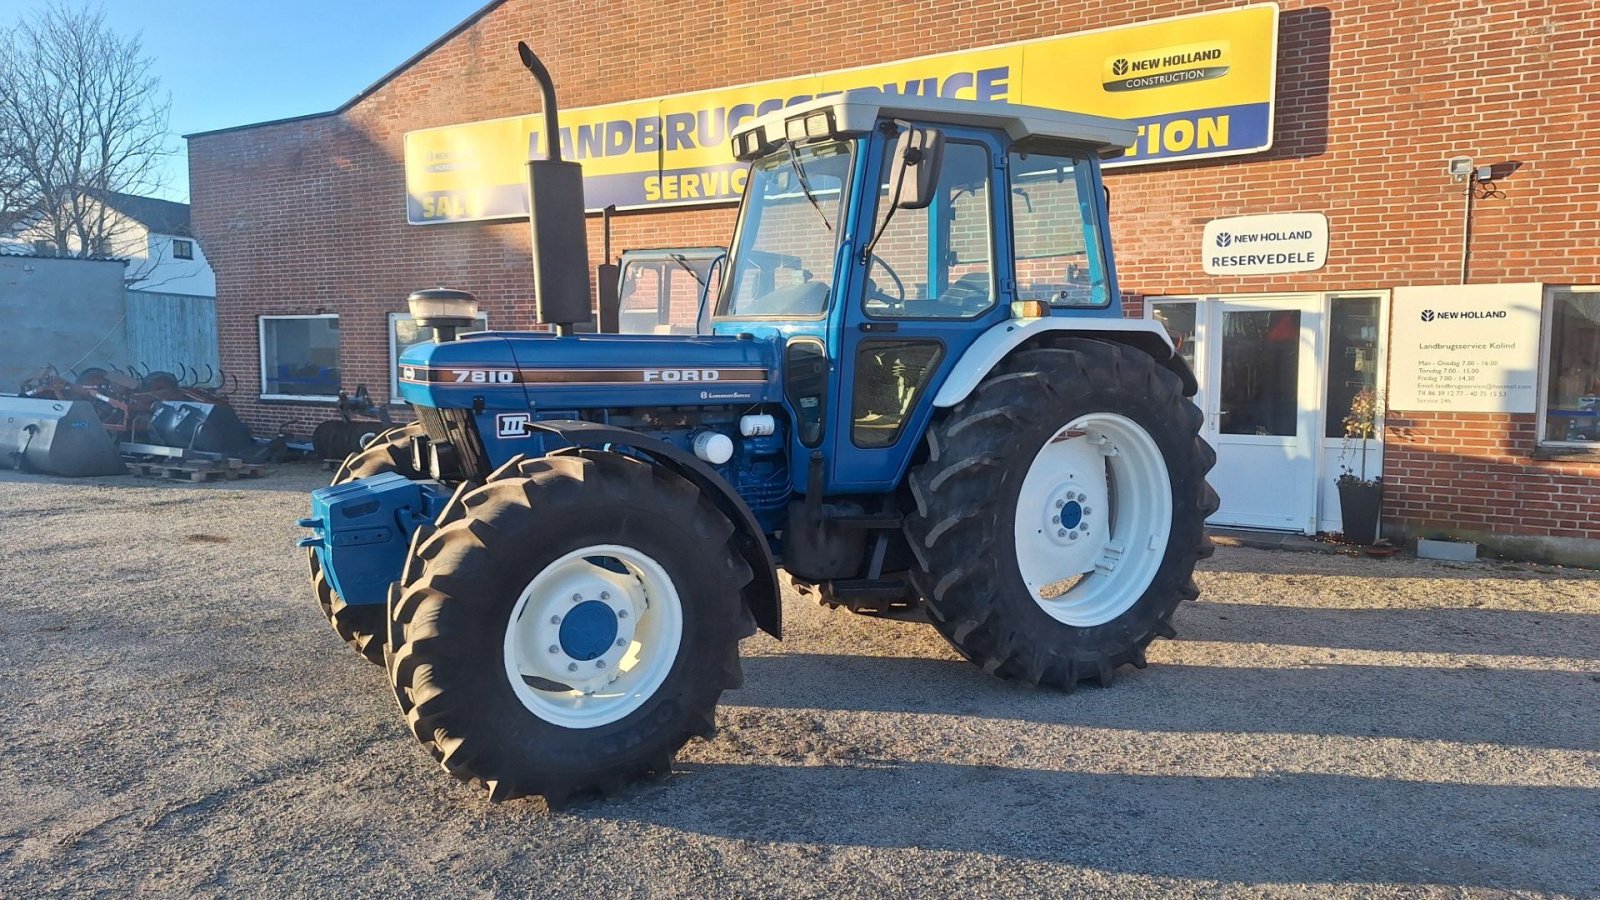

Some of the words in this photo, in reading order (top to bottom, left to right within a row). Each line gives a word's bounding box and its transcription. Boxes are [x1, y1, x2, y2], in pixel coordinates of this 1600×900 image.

[1131, 57, 1160, 72] NEW
[1163, 49, 1221, 67] HOLLAND
[1126, 69, 1205, 88] CONSTRUCTION
[1234, 234, 1259, 243] NEW
[1260, 230, 1313, 241] HOLLAND
[1211, 252, 1315, 267] RESERVEDELE
[1460, 311, 1506, 319] HOLLAND
[1419, 343, 1487, 351] Landbrugsservice
[452, 370, 514, 383] 7810
[643, 370, 719, 382] FORD
